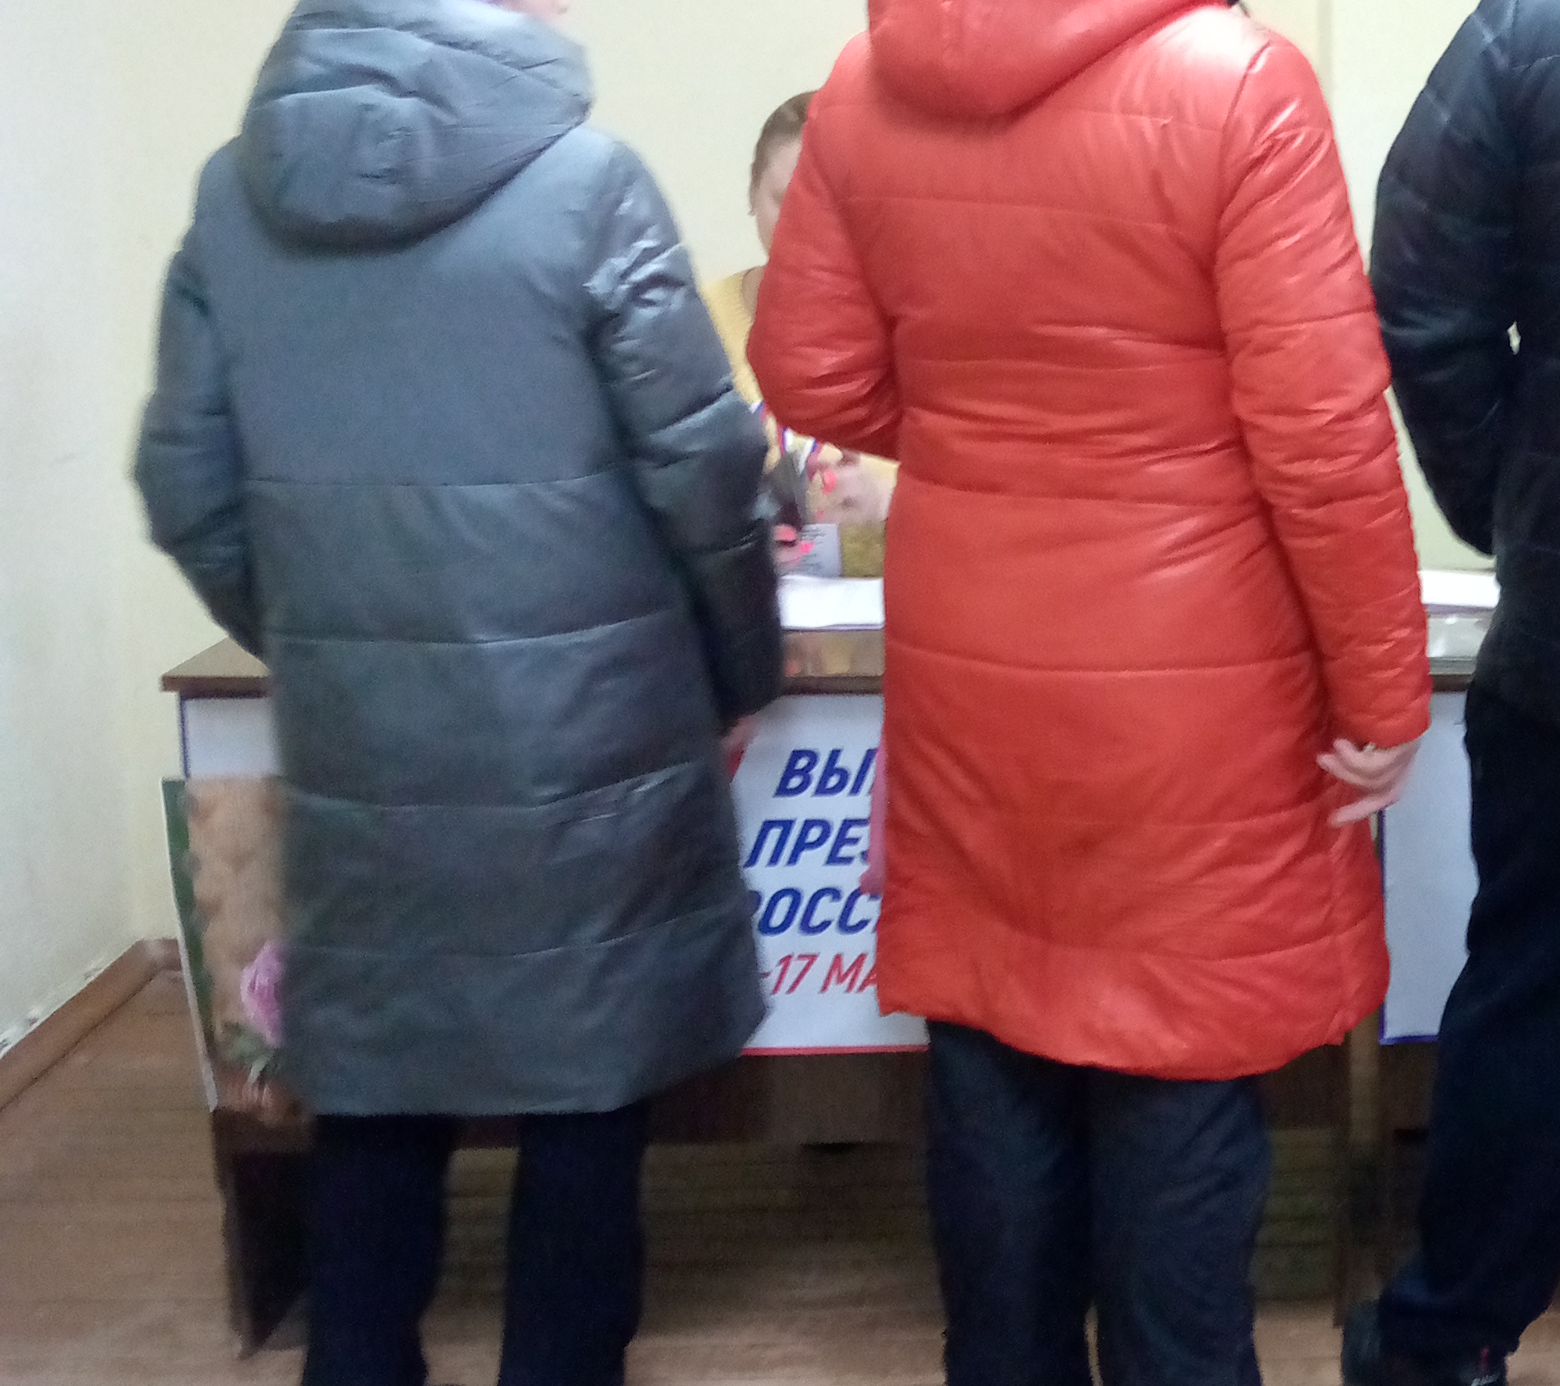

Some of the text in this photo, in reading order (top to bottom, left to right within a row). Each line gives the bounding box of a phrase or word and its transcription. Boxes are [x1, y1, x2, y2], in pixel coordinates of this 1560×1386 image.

[773, 749, 876, 797] ВЫ
[744, 818, 869, 867] ПРЕ
[749, 887, 882, 936] ОСС
